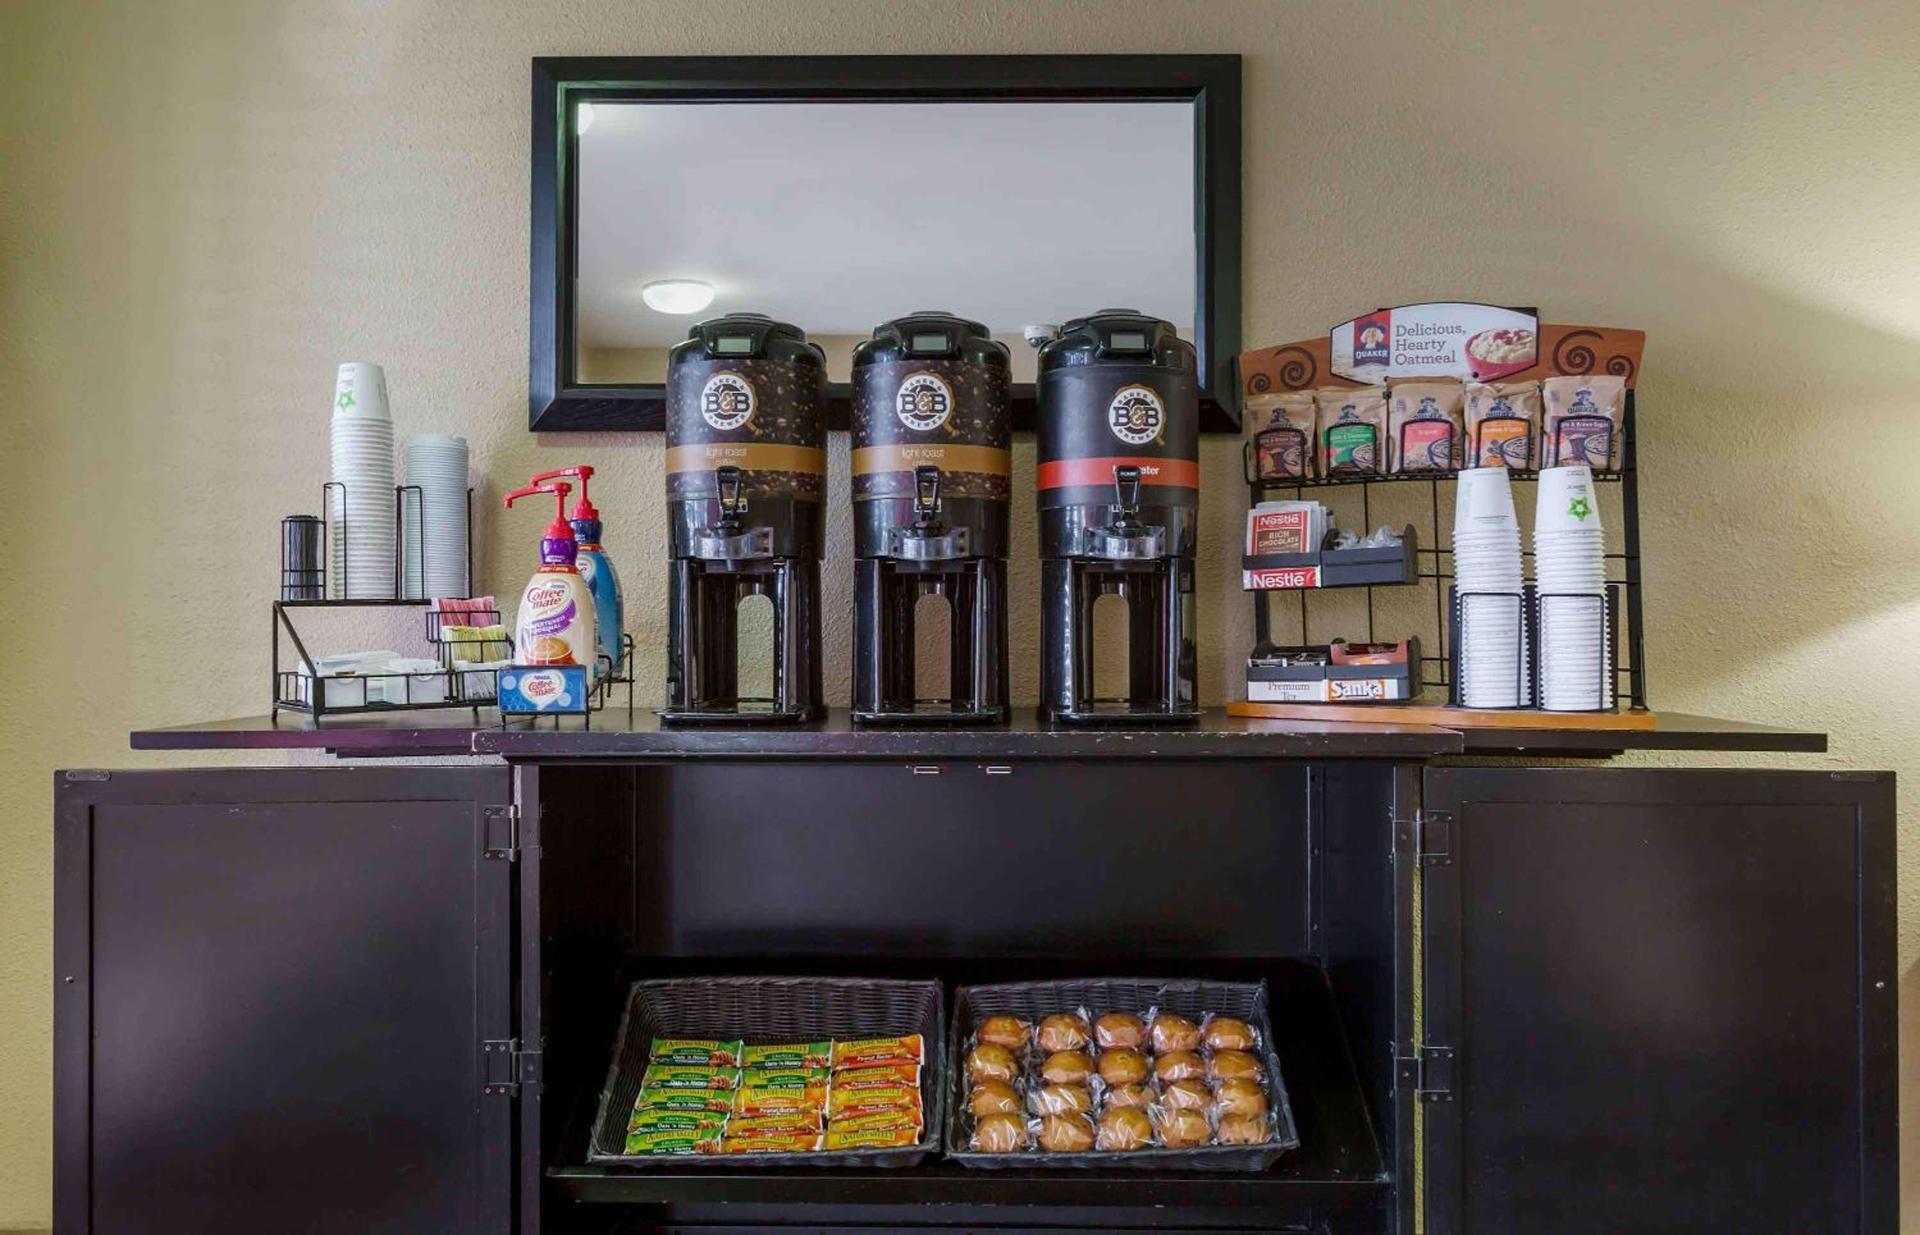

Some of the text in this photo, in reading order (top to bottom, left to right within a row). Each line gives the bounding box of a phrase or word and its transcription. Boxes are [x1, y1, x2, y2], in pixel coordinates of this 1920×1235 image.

[1395, 323, 1466, 337] Delicious,
[1395, 339, 1446, 352] Hearty
[1356, 349, 1388, 360] QUAKER
[1395, 351, 1456, 366] Oatmeal
[1269, 530, 1290, 539] RICH
[1268, 681, 1311, 690] Premium
[1329, 680, 1384, 700] Sanka
